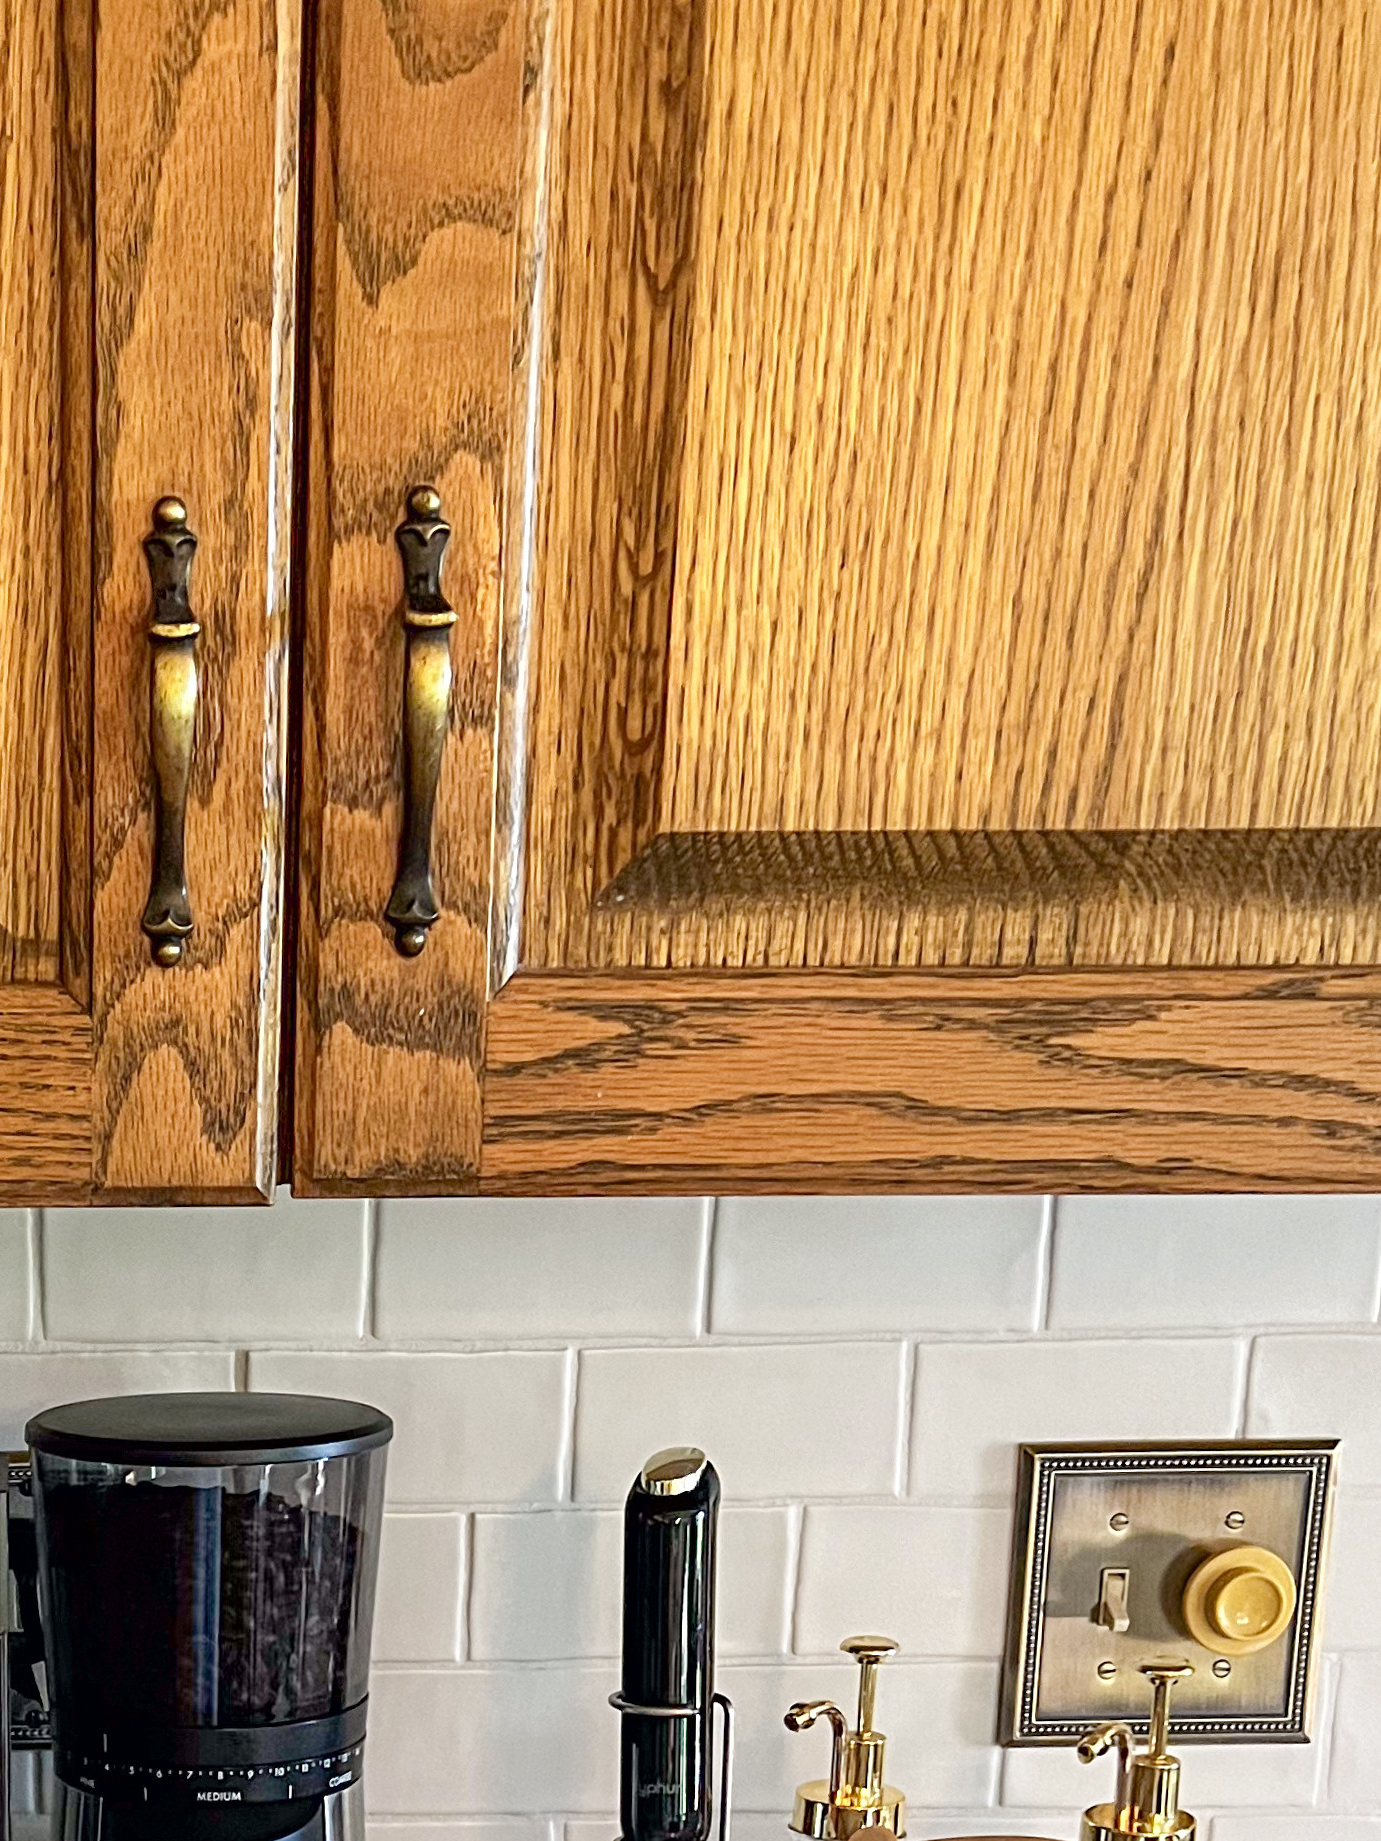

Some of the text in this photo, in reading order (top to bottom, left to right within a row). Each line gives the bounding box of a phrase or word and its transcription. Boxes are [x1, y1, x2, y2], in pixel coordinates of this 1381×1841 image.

[154, 1768, 163, 1779] 6
[186, 1770, 194, 1780] 7
[216, 1771, 225, 1781] 8
[246, 1770, 255, 1780] 9
[274, 1767, 285, 1778] 10
[196, 1791, 242, 1802] MEDIUM
